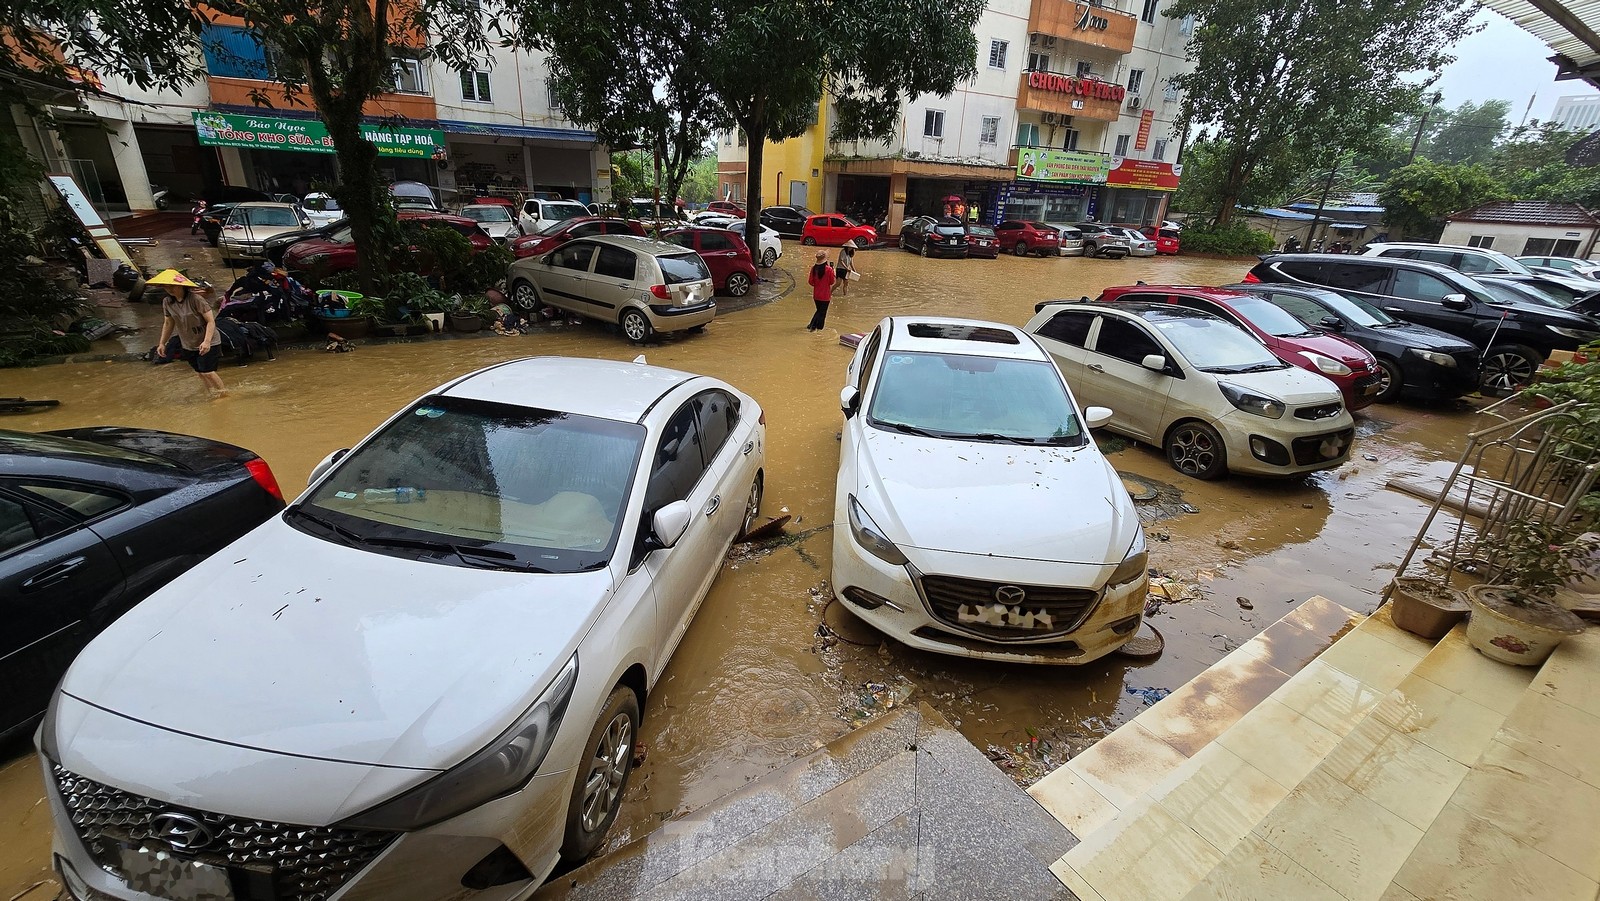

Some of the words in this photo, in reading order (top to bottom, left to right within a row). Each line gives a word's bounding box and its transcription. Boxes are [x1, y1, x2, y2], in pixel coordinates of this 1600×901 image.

[1030, 72, 1074, 93] CHUNG
[274, 121, 306, 132] Ngọc
[217, 127, 255, 141] TỔNG
[257, 132, 286, 144] KHO
[288, 132, 314, 146] SỮA
[365, 131, 393, 143] HÀNG
[394, 134, 412, 146] TẠP
[414, 134, 434, 146] HOÁ
[407, 147, 424, 156] dùng
